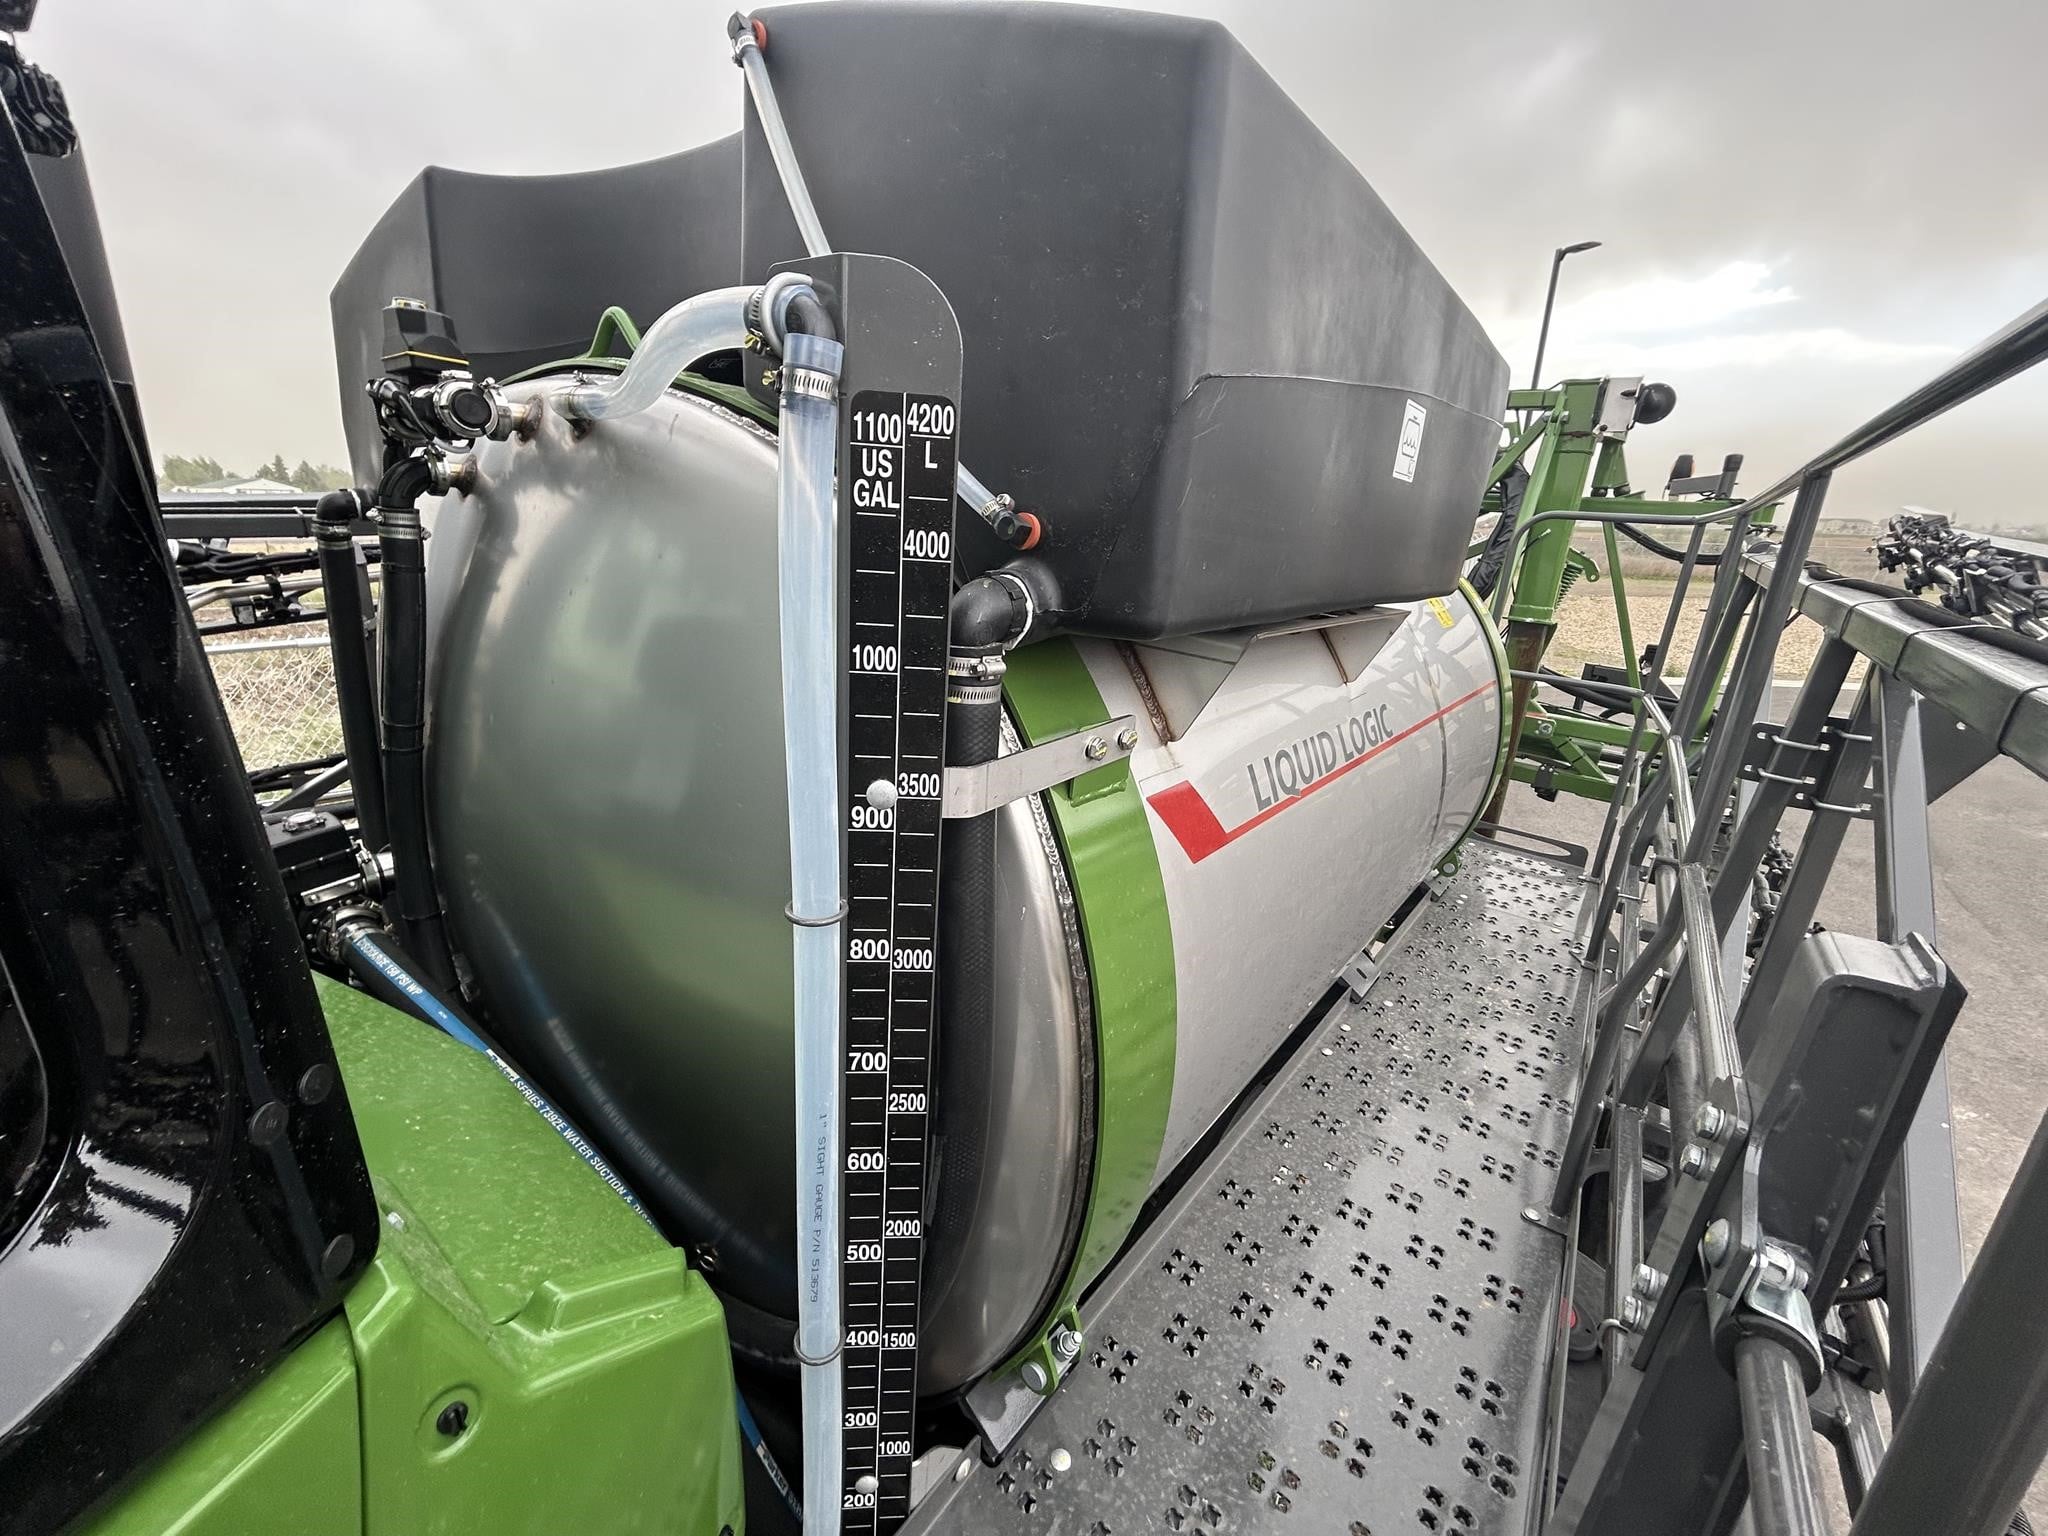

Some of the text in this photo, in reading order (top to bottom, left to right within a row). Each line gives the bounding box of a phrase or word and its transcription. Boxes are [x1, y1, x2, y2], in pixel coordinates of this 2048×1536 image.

[853, 410, 901, 443] 1100
[906, 402, 954, 435] 4200
[861, 448, 893, 478] US
[924, 440, 938, 469] L
[853, 478, 900, 509] GAL
[903, 529, 950, 559] 4000
[852, 643, 897, 672] 1000
[1246, 703, 1394, 812] LIQUID LOGIC
[898, 772, 940, 797] 3500
[850, 805, 893, 829] 900
[849, 938, 890, 960] 800
[893, 948, 933, 970] 3000
[394, 973, 412, 987] PSI
[406, 983, 423, 995] WP
[848, 1052, 887, 1072] 700
[888, 1092, 927, 1112] 2500
[540, 1105, 568, 1132] 7392E
[563, 1127, 593, 1159] WATER
[590, 1157, 626, 1195] SUCTION
[815, 1135, 827, 1176] SIGHT
[847, 1151, 884, 1171] 600
[813, 1183, 824, 1223] GAUGE
[885, 1219, 921, 1236] 2000
[811, 1228, 822, 1253] P/N
[846, 1244, 882, 1261] 500
[845, 1330, 880, 1346] 400
[882, 1332, 916, 1348] 1500
[844, 1412, 877, 1428] 300
[878, 1440, 911, 1455] 1000
[843, 1493, 875, 1508] 200
